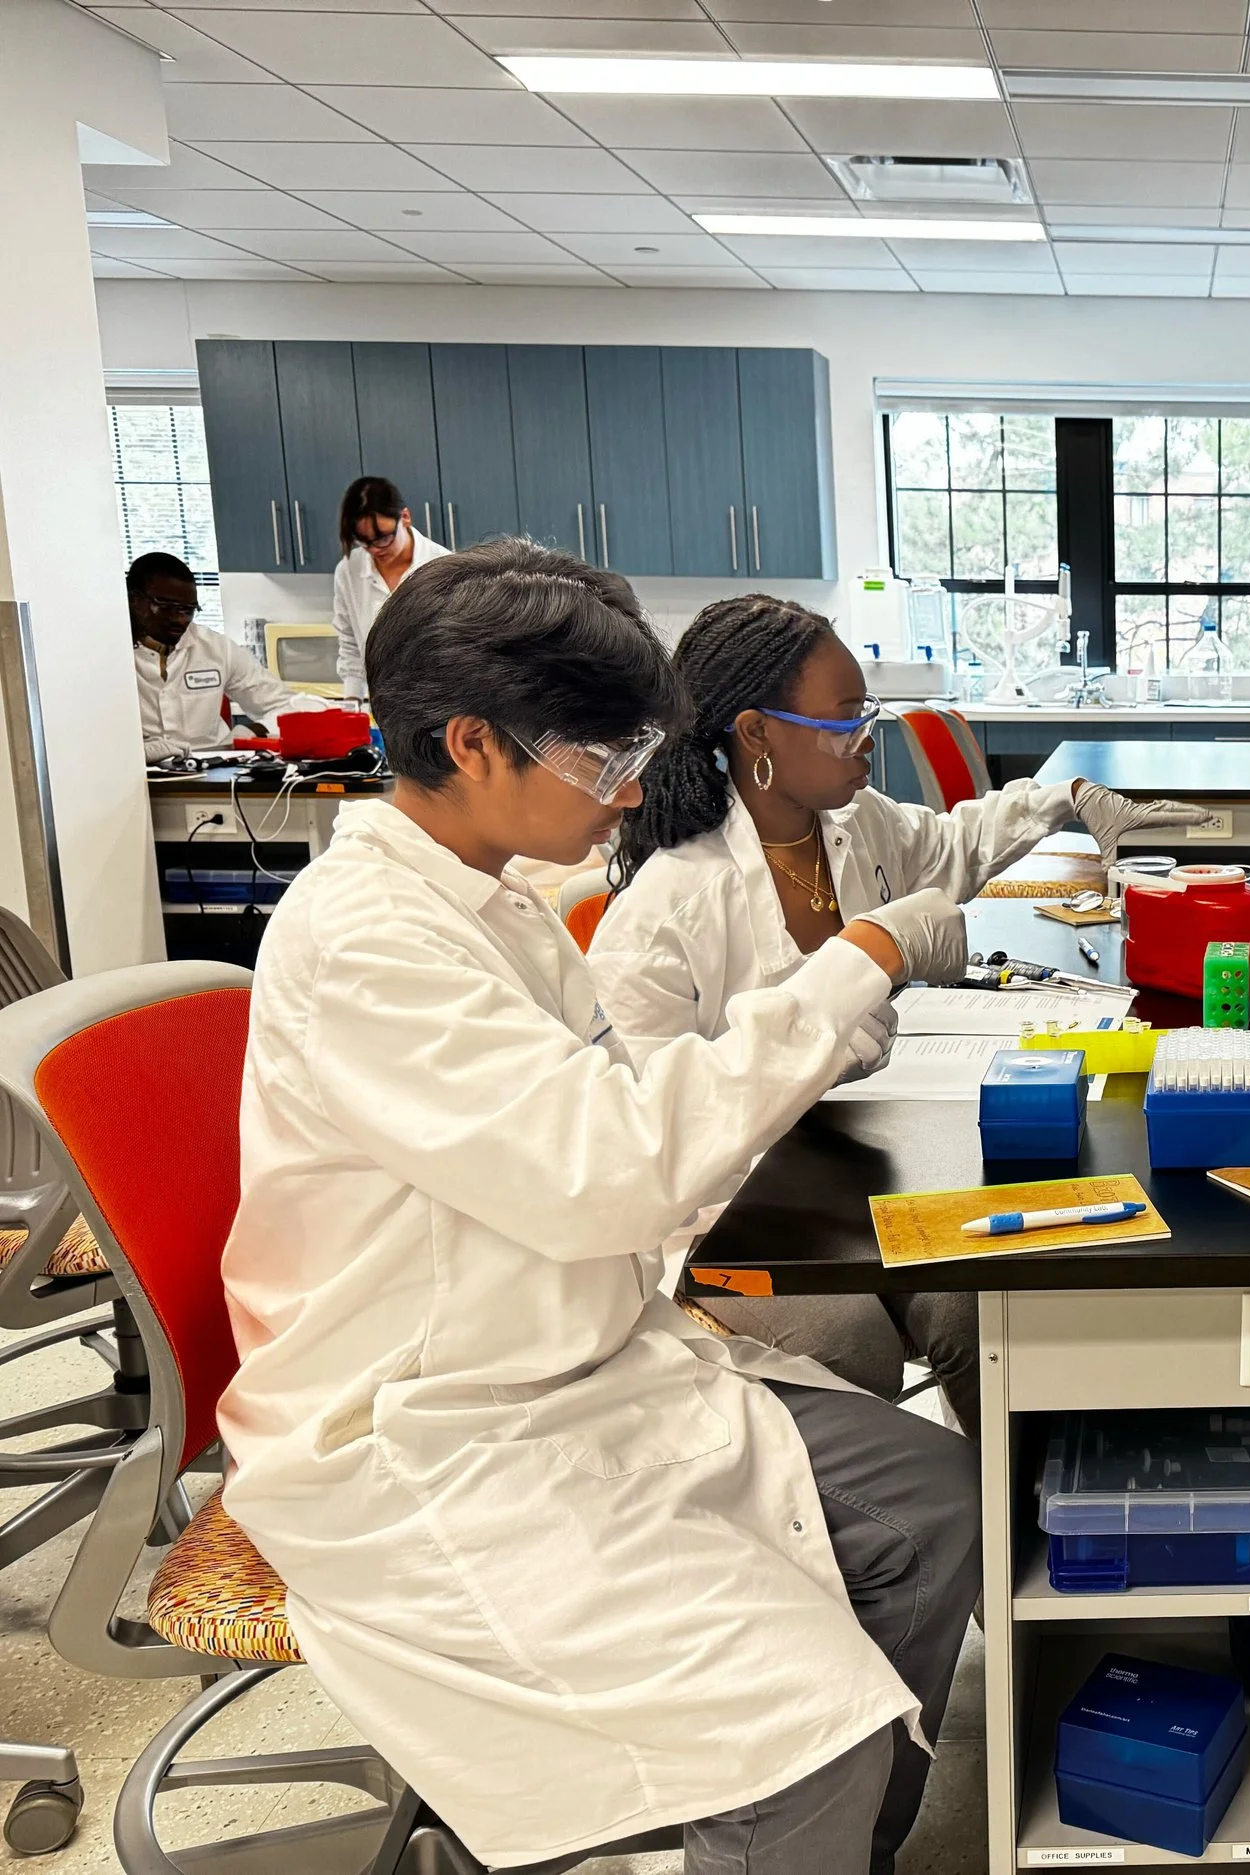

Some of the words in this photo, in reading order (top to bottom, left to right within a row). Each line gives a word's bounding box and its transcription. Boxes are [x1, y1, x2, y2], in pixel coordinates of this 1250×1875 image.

[719, 1272, 732, 1287] 7
[1105, 1672, 1139, 1684] scientific
[1109, 1667, 1139, 1679] thermo
[1041, 1852, 1069, 1860] OFFICE
[1075, 1851, 1113, 1860] SUPPLIES
